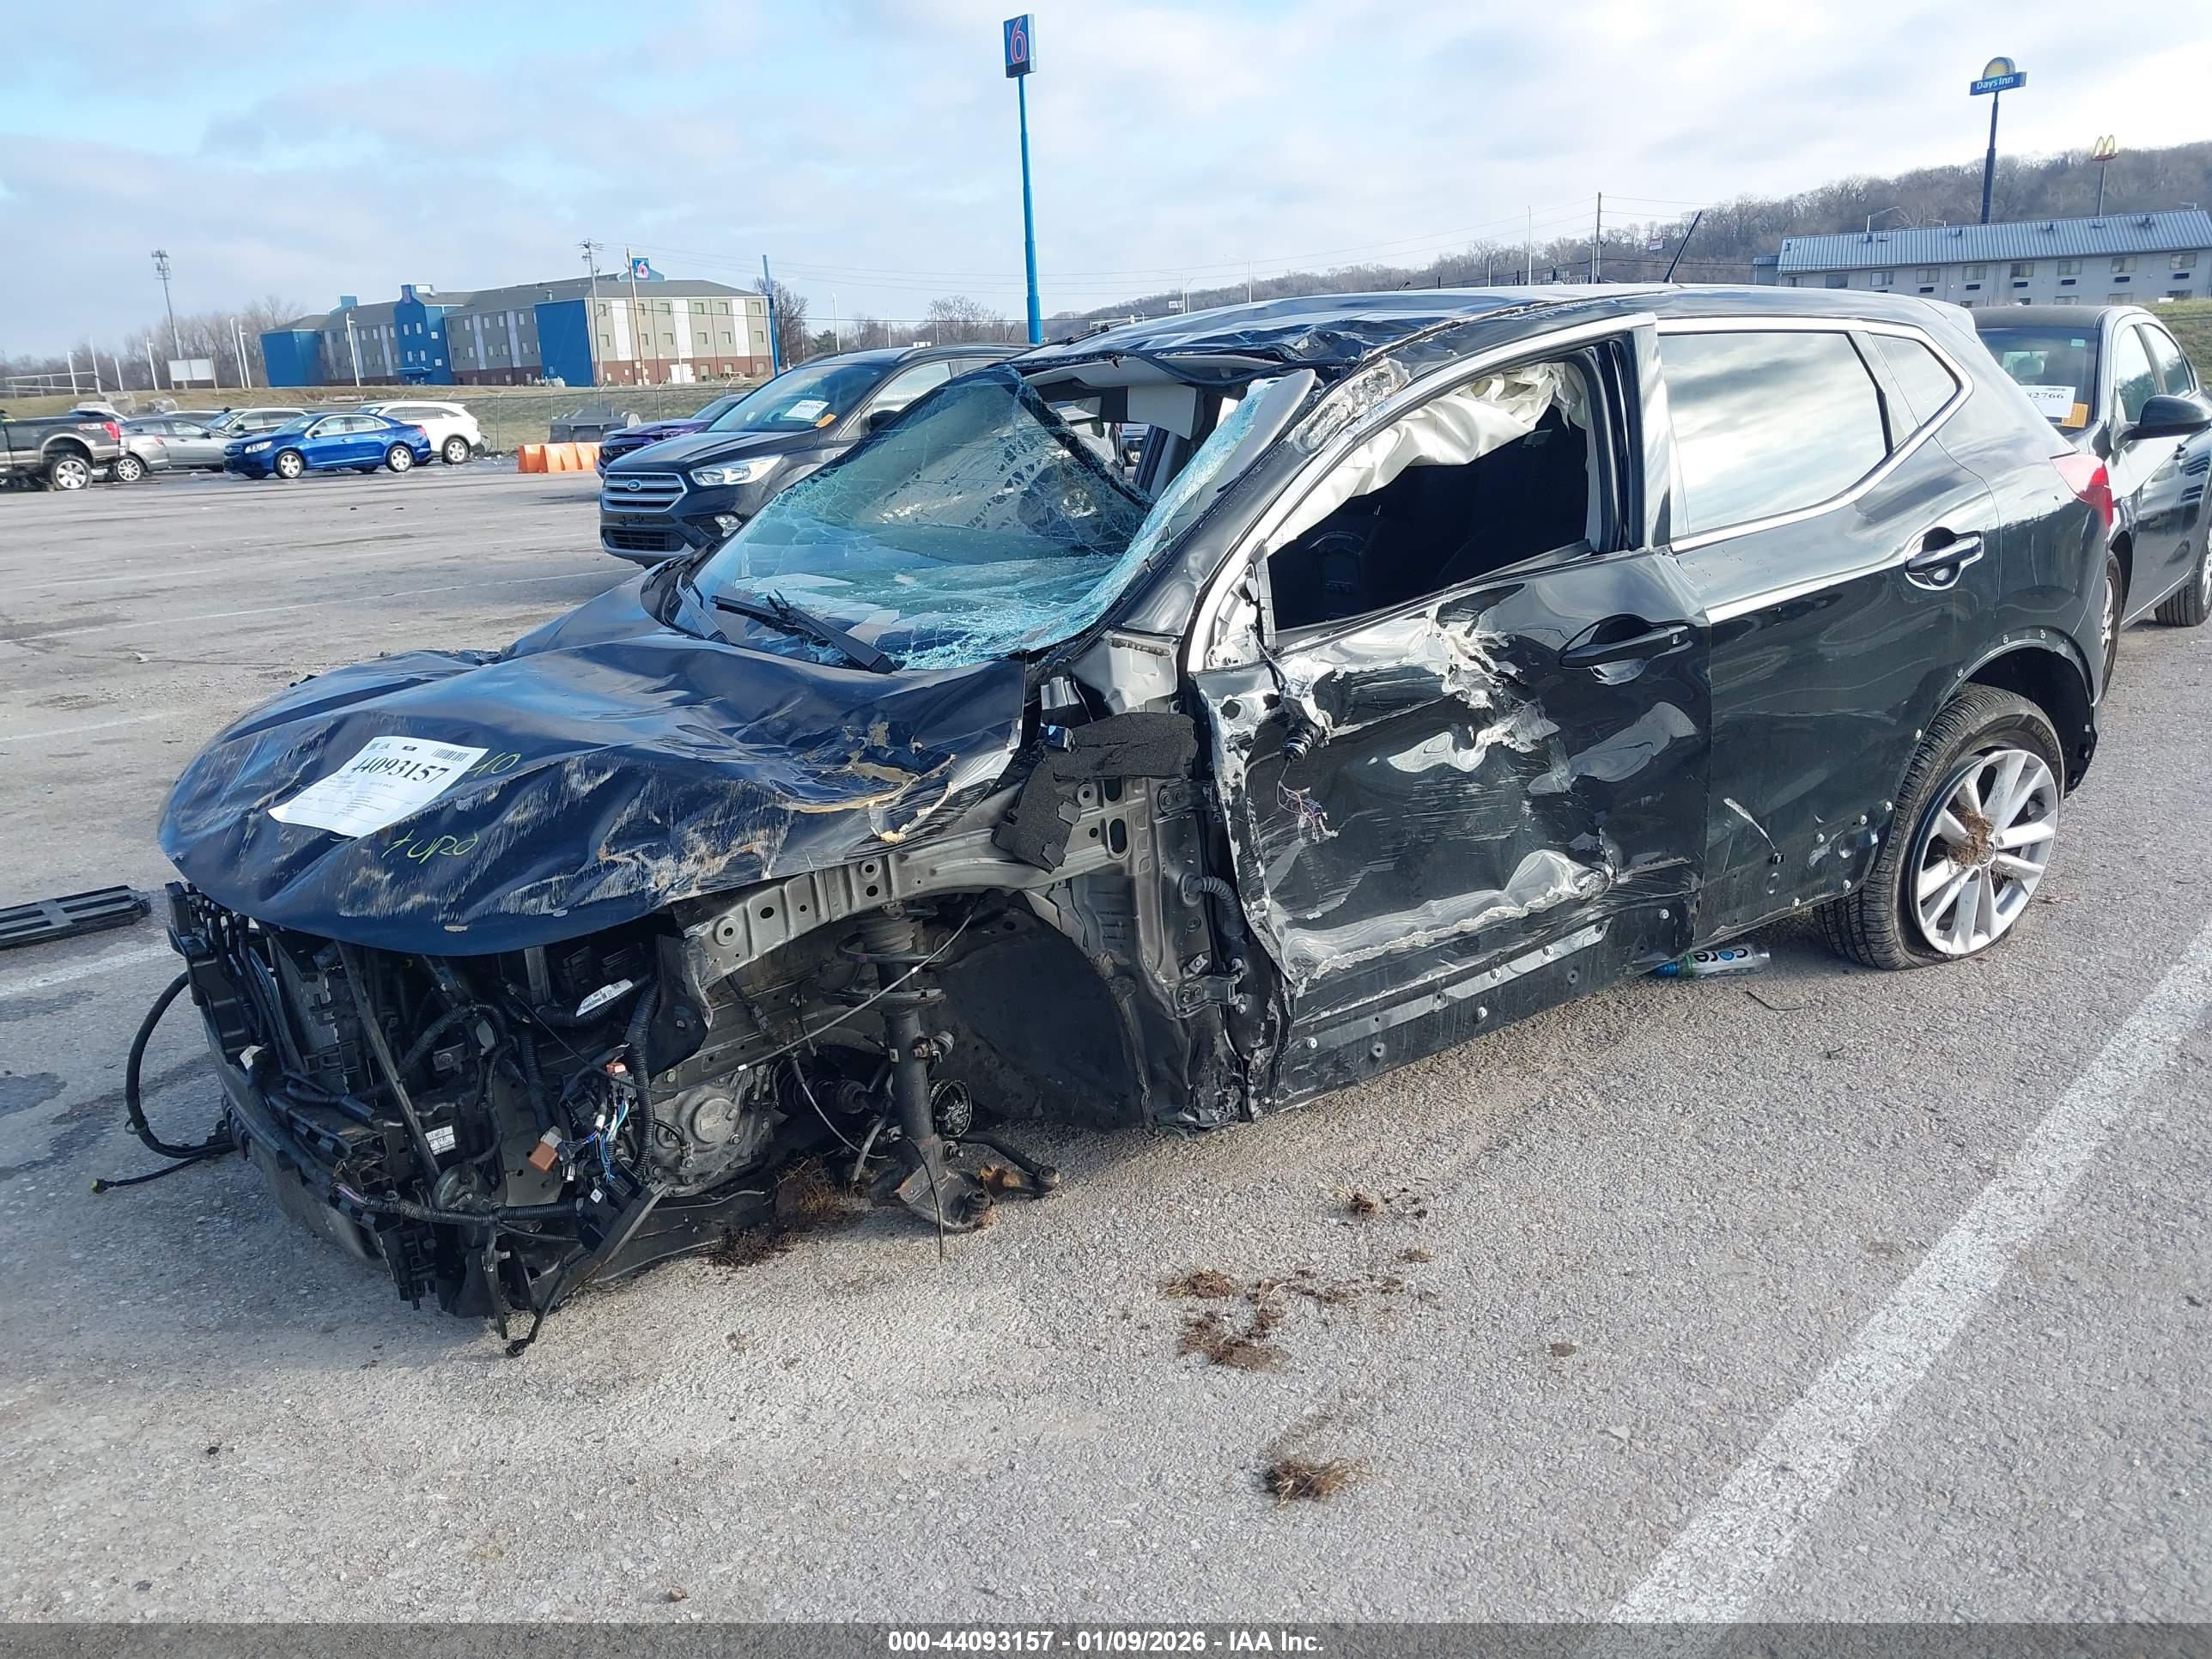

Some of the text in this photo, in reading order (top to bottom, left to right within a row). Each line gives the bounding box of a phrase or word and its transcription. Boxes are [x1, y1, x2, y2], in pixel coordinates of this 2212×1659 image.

[1011, 17, 1028, 64] 6
[1976, 79, 1998, 90] Days
[1998, 76, 2014, 86] Inn
[637, 261, 648, 278] 6
